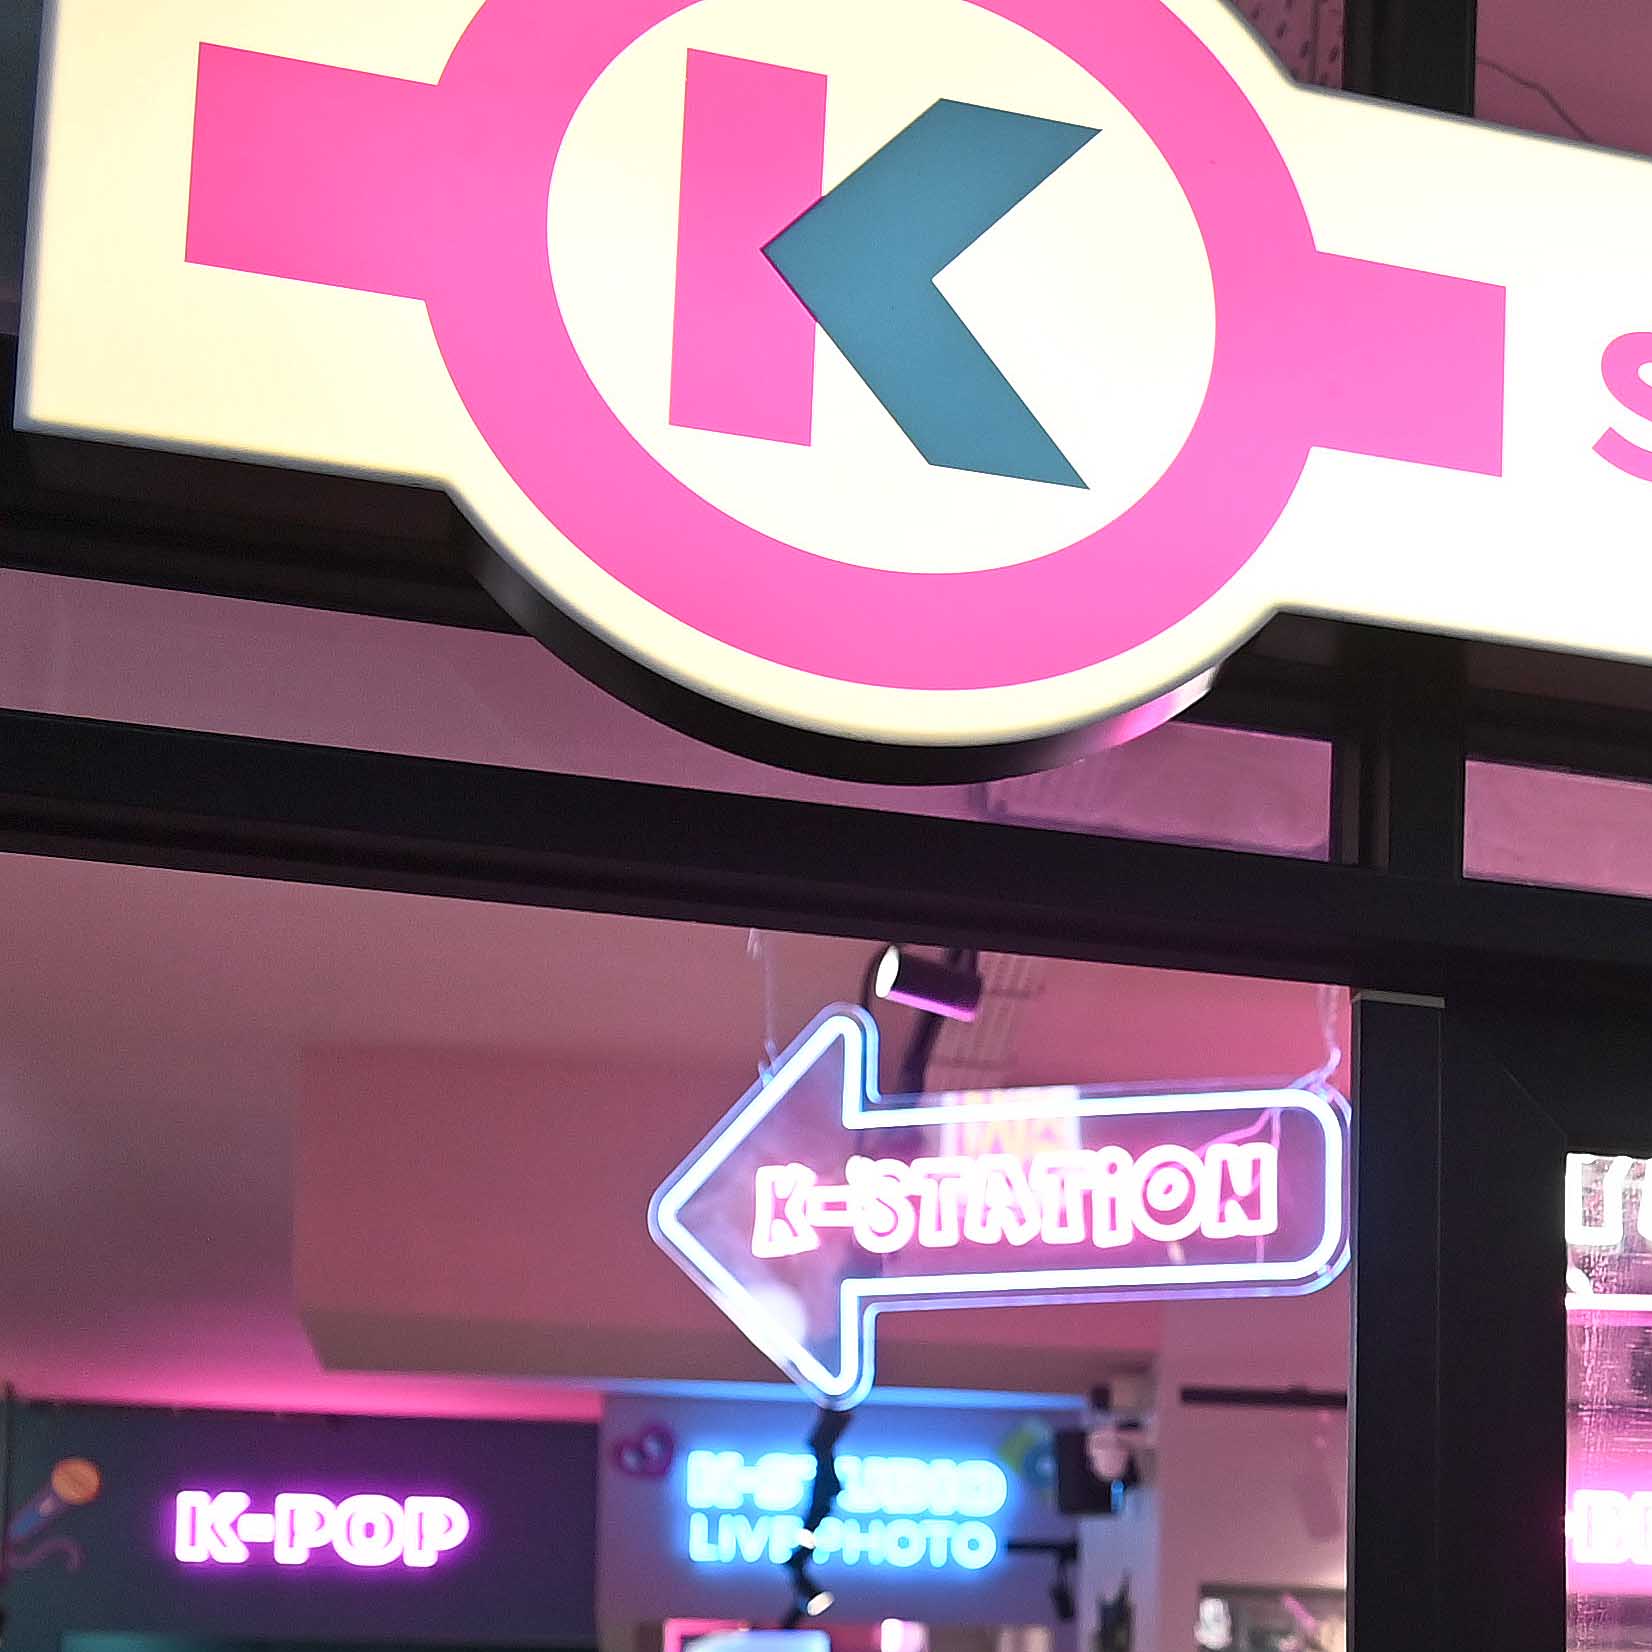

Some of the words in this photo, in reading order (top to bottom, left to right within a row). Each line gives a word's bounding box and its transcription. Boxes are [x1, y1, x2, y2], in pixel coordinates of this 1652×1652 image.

[669, 48, 1102, 489] K
[174, 1490, 471, 1568] K-POP
[812, 1516, 998, 1570] PHOTO
